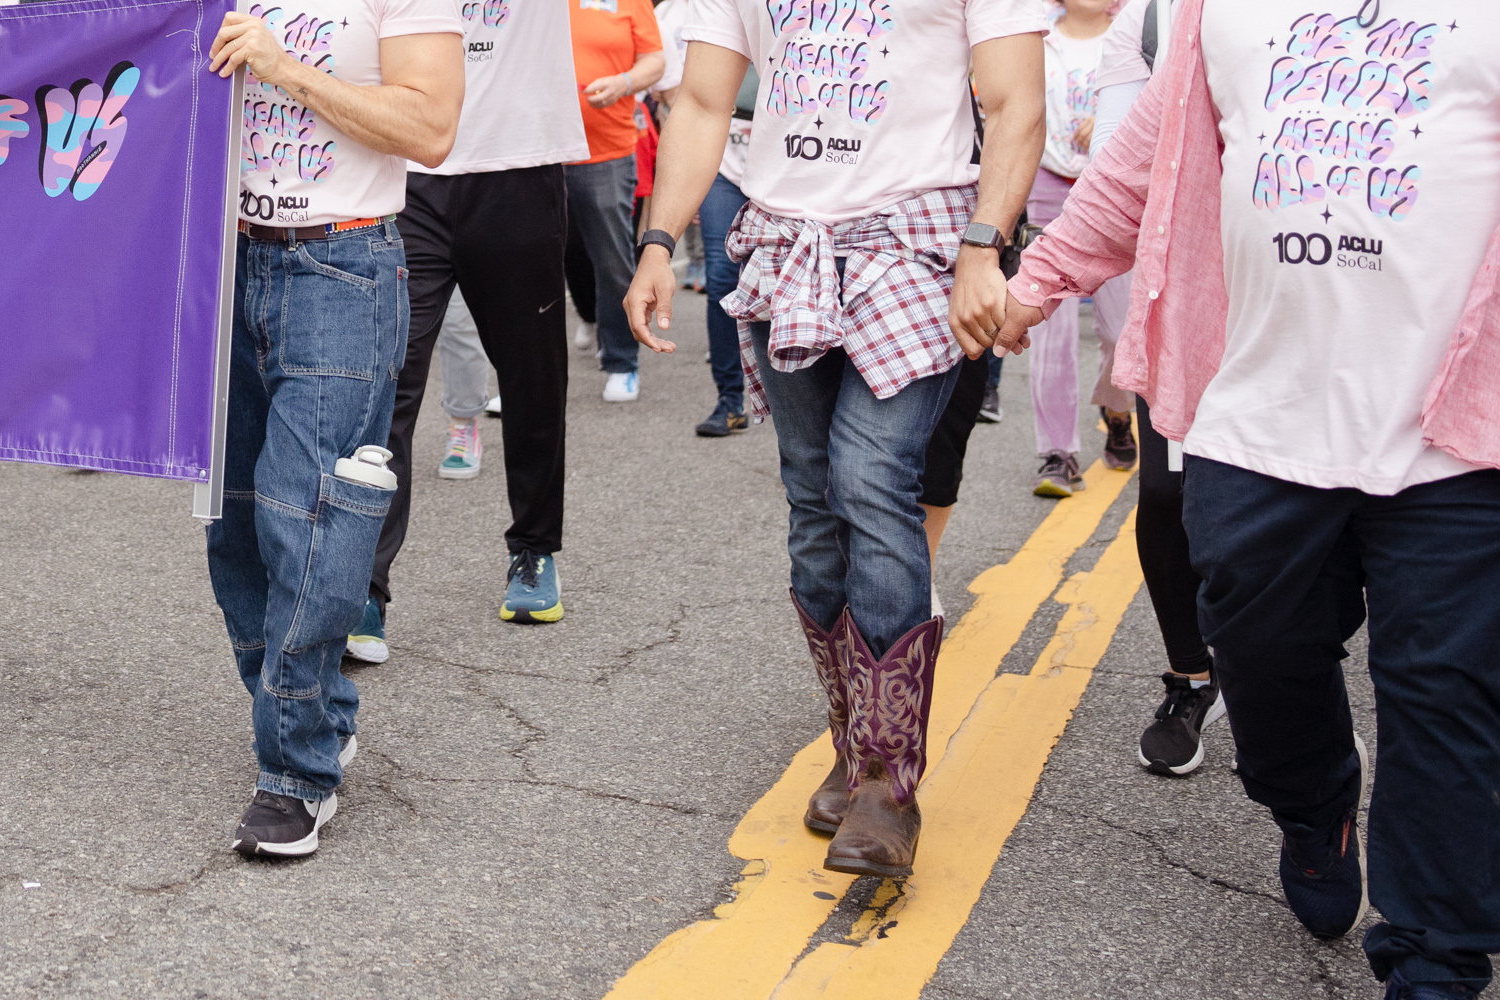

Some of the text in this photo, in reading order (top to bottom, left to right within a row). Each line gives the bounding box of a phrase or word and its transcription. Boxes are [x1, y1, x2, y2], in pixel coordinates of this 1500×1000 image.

[462, 3, 483, 23] OF
[284, 12, 337, 53] THE
[468, 41, 494, 52] ACLU
[1286, 13, 1441, 62] WE THE
[467, 52, 493, 63] SoCal
[781, 41, 872, 82] MEANS
[767, 70, 891, 126] ALL OF US
[1264, 56, 1436, 119] PEOPLE
[34, 60, 141, 201] US
[784, 133, 861, 161] 100 ACLU
[1273, 117, 1399, 165] MEANS
[272, 141, 297, 170] OF
[298, 140, 338, 183] US
[825, 152, 859, 165] SoCal
[240, 189, 309, 221] 100 ACLU
[1252, 152, 1423, 222] ALL OF US
[277, 211, 309, 223] SoCal
[1272, 232, 1383, 265] 100 ACLU
[1337, 253, 1383, 272] SoCal
